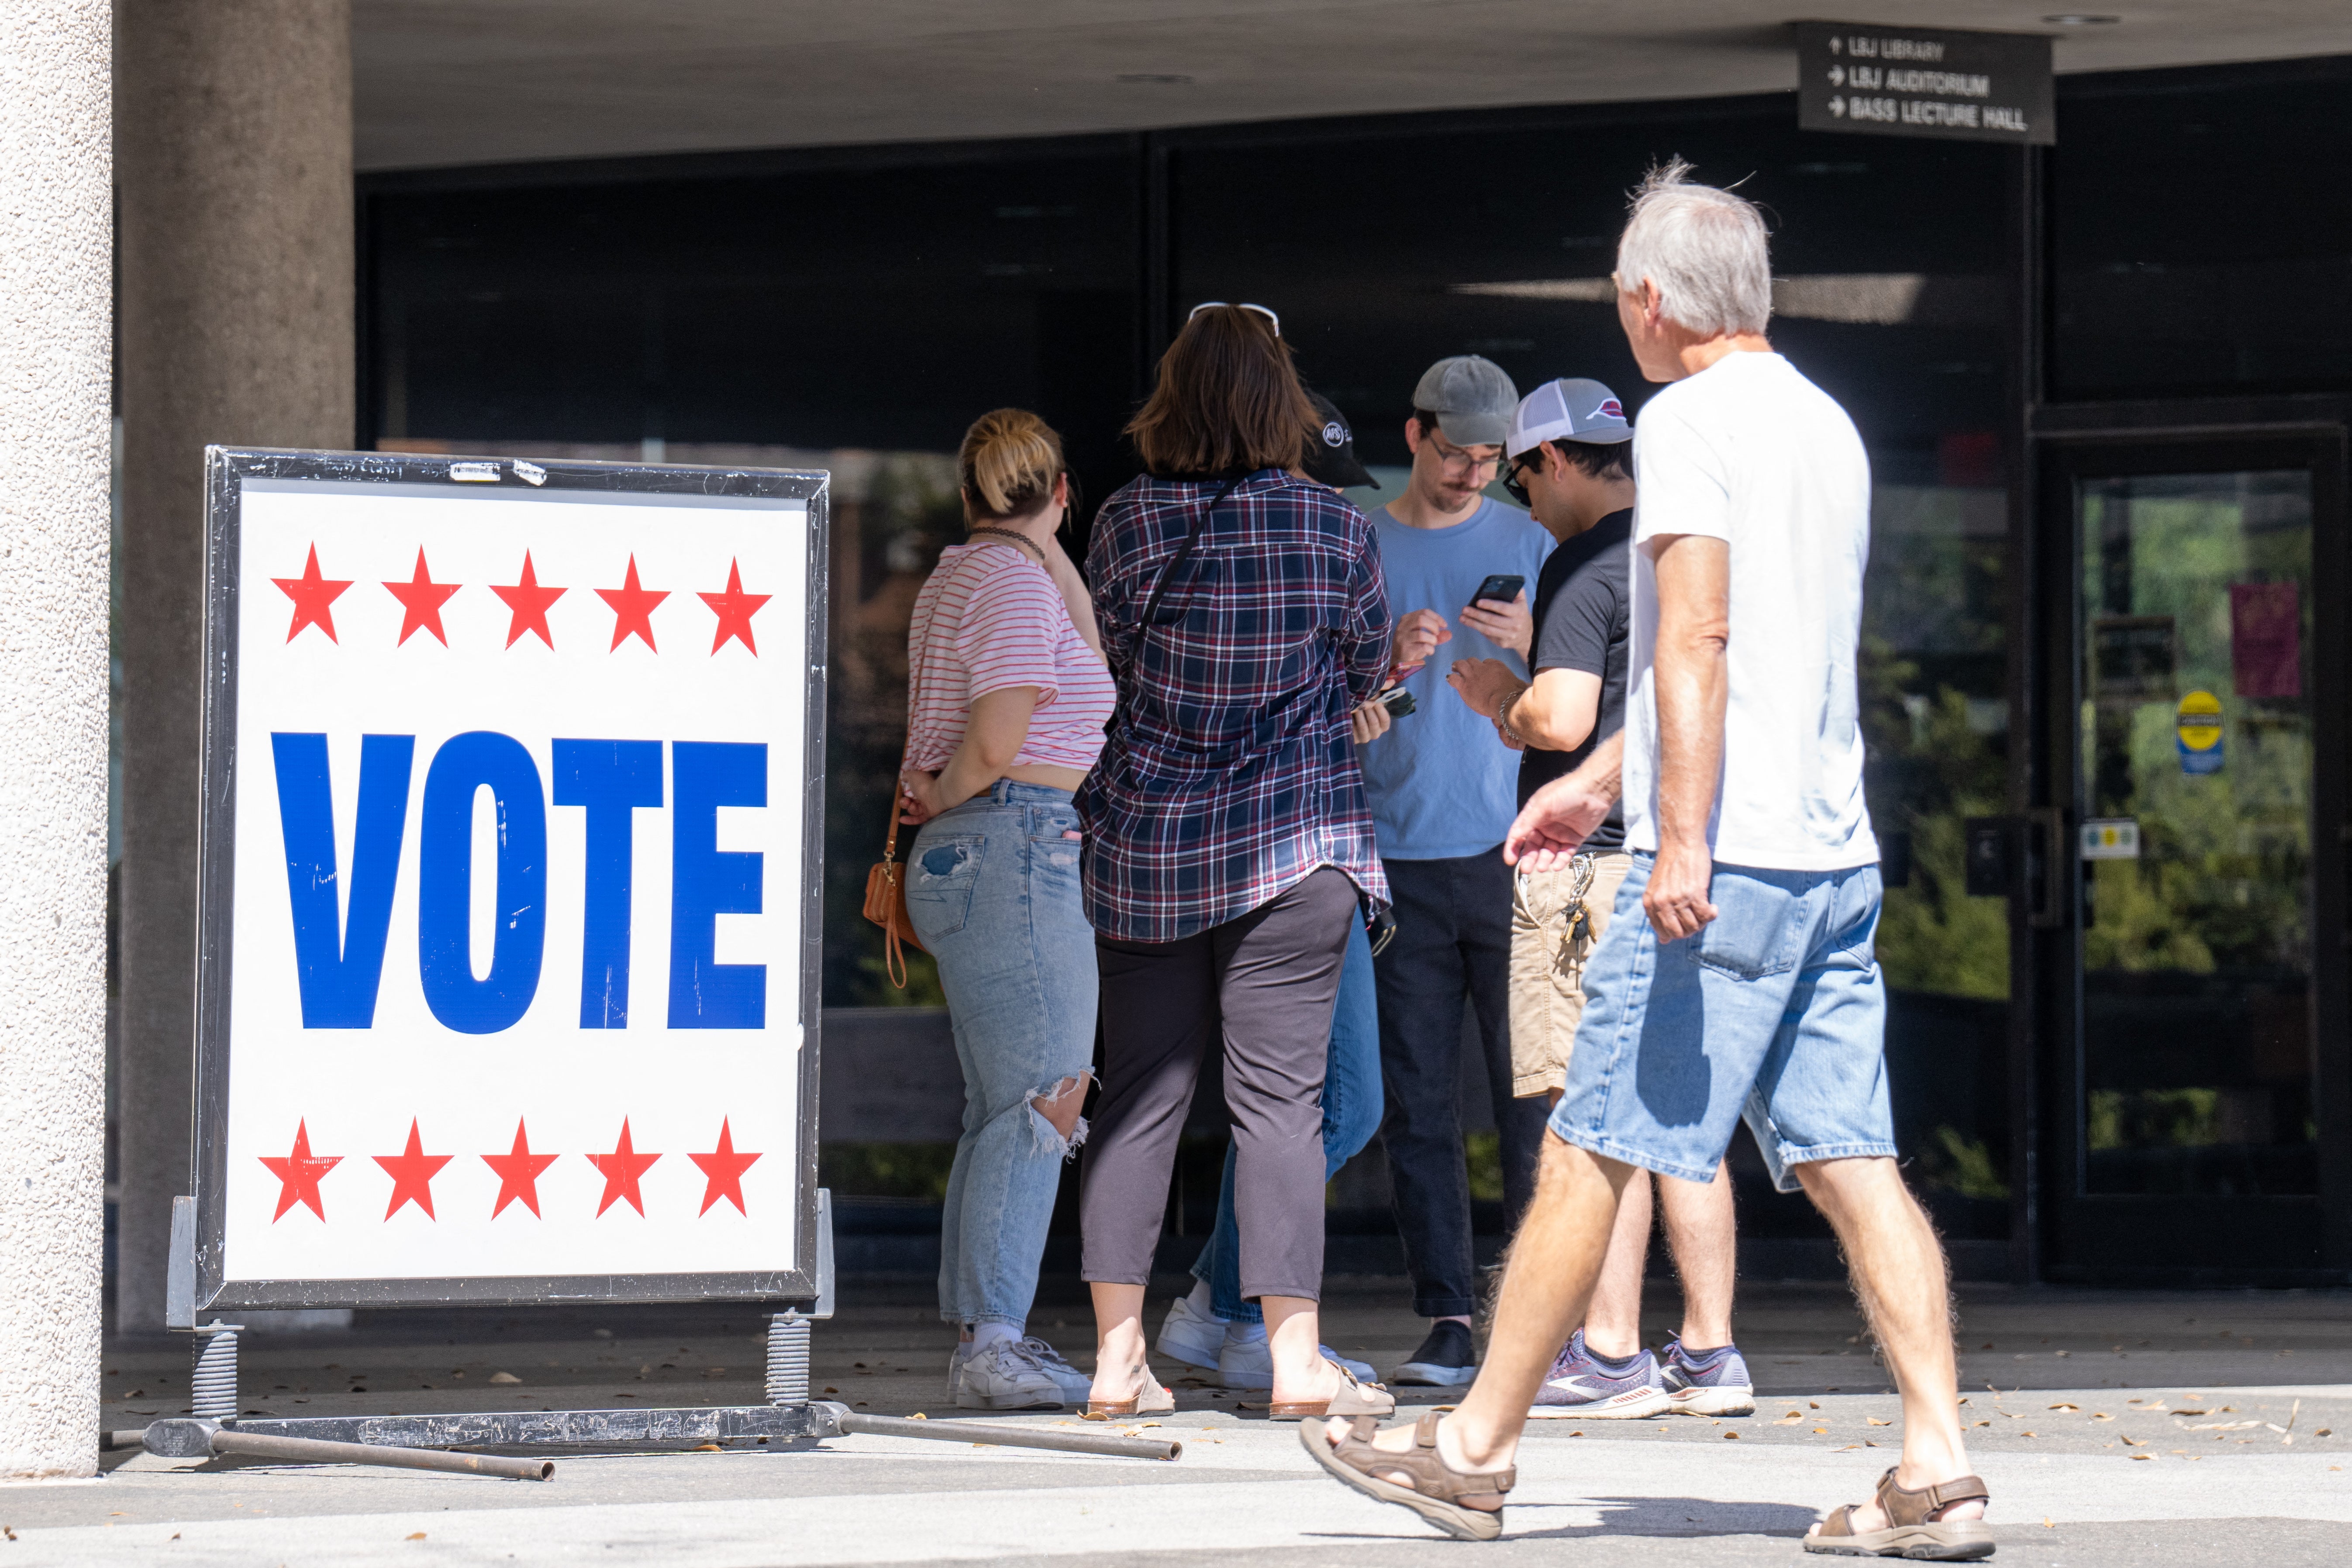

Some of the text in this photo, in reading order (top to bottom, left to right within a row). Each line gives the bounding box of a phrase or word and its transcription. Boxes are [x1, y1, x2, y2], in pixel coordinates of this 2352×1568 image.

[1848, 36, 1944, 61] LBJ LIBRARY
[1848, 65, 1990, 97] LBJ AUDITORIUM
[1849, 96, 2028, 131] BASS LECTURE HALL
[270, 730, 768, 1035] VOTE
